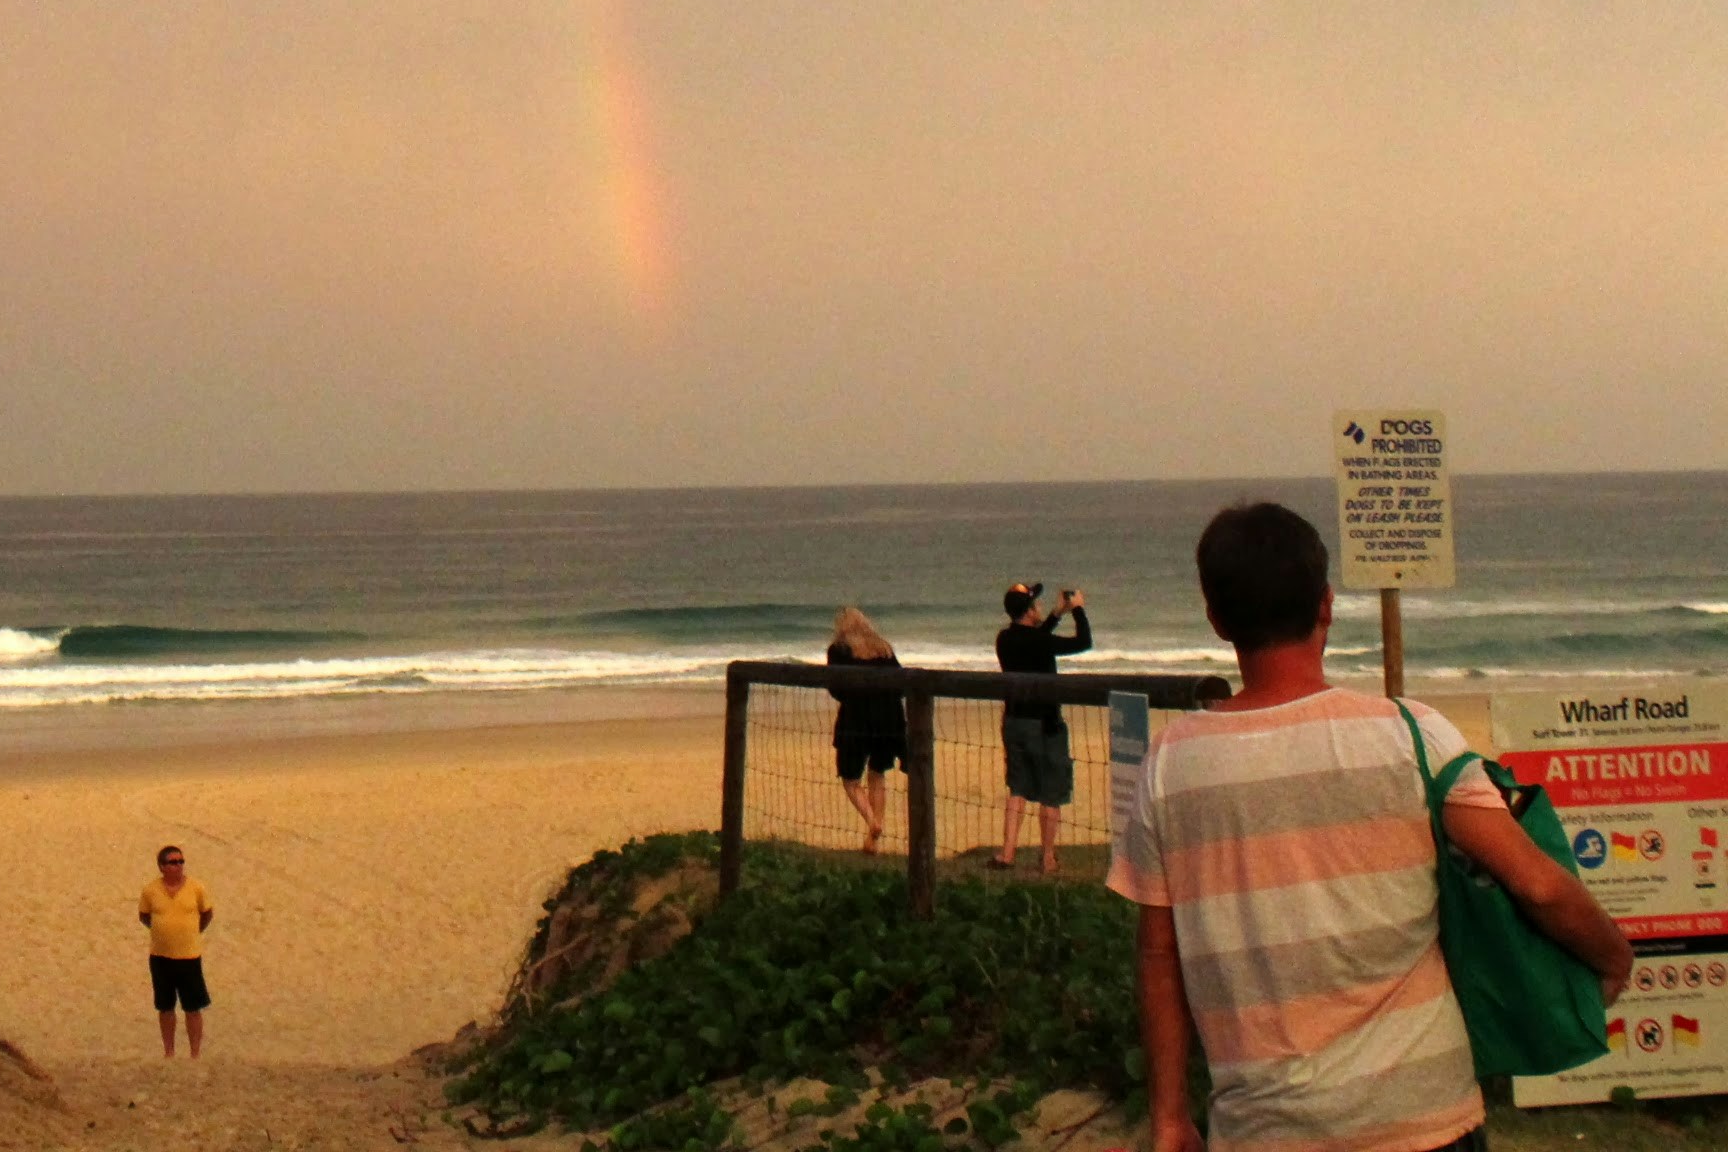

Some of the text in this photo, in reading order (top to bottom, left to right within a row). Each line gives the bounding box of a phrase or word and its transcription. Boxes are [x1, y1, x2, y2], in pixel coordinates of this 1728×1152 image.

[1380, 419, 1433, 436] DOGS
[1372, 438, 1442, 454] PROHIBITED
[1373, 458, 1401, 468] FAGS
[1361, 470, 1403, 480] BATHING
[1358, 486, 1431, 497] OTHER TIMES
[1345, 499, 1444, 510] DOGS TO BE KEPT
[1346, 512, 1364, 523] ON
[1366, 512, 1401, 523] LEASH
[1349, 529, 1442, 539] COLLECT AND DISPOSE
[1560, 695, 1689, 723] Wharf Road
[1545, 749, 1712, 783] ATTENTION
